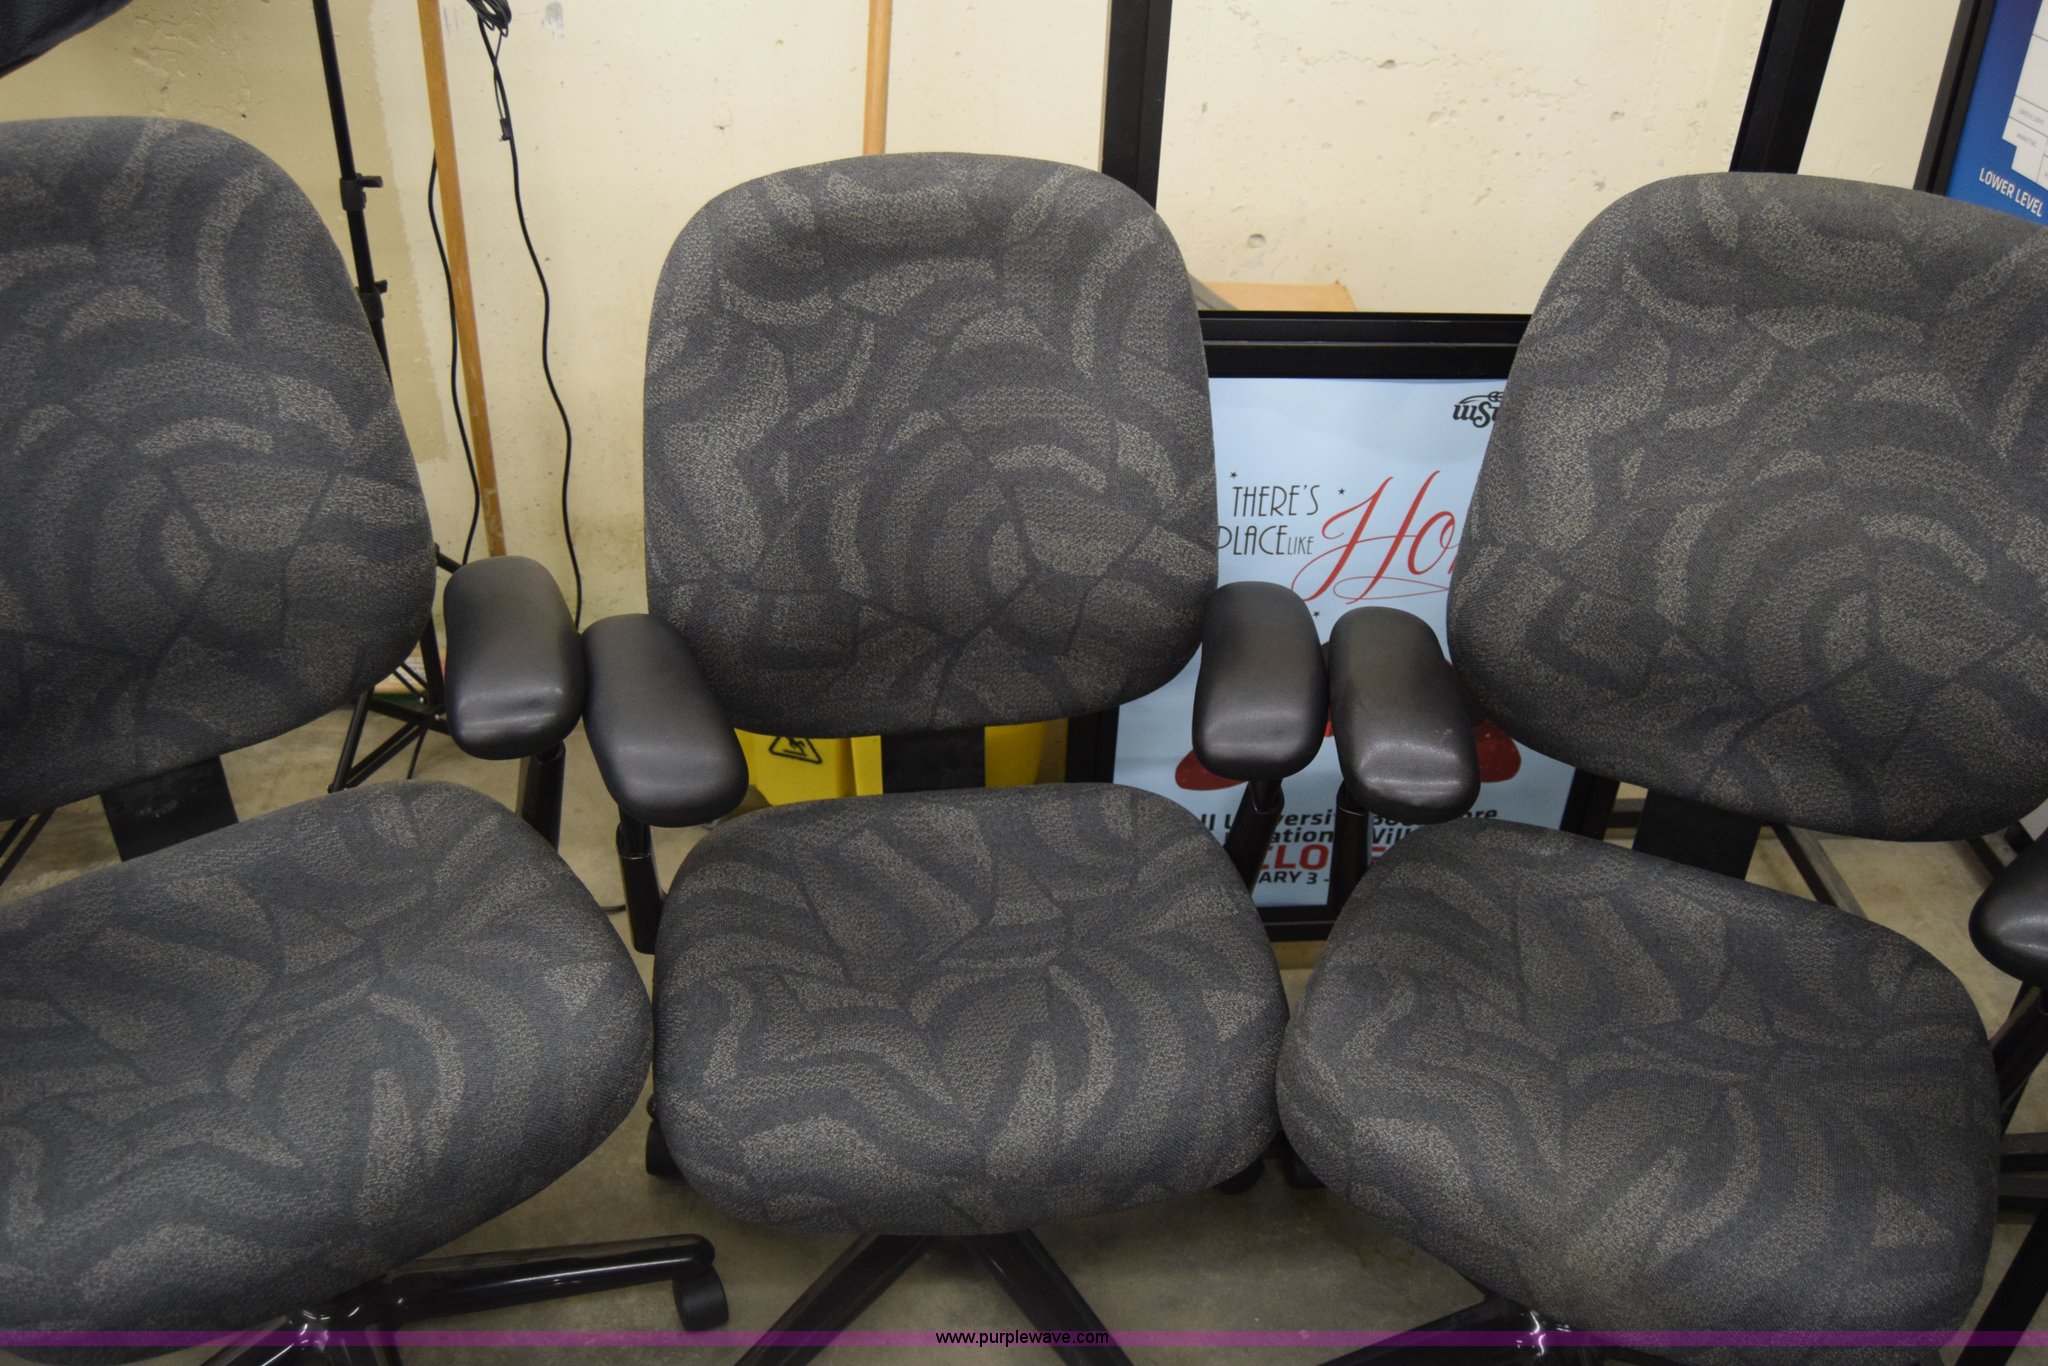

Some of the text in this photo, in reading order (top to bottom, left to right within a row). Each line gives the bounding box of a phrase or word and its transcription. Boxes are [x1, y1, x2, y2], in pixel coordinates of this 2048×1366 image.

[1979, 168, 2043, 217] LOWER LEVEL
[1232, 485, 1320, 517] THERE'S
[1287, 536, 1314, 555] LIKE
[1306, 872, 1318, 885] 3
